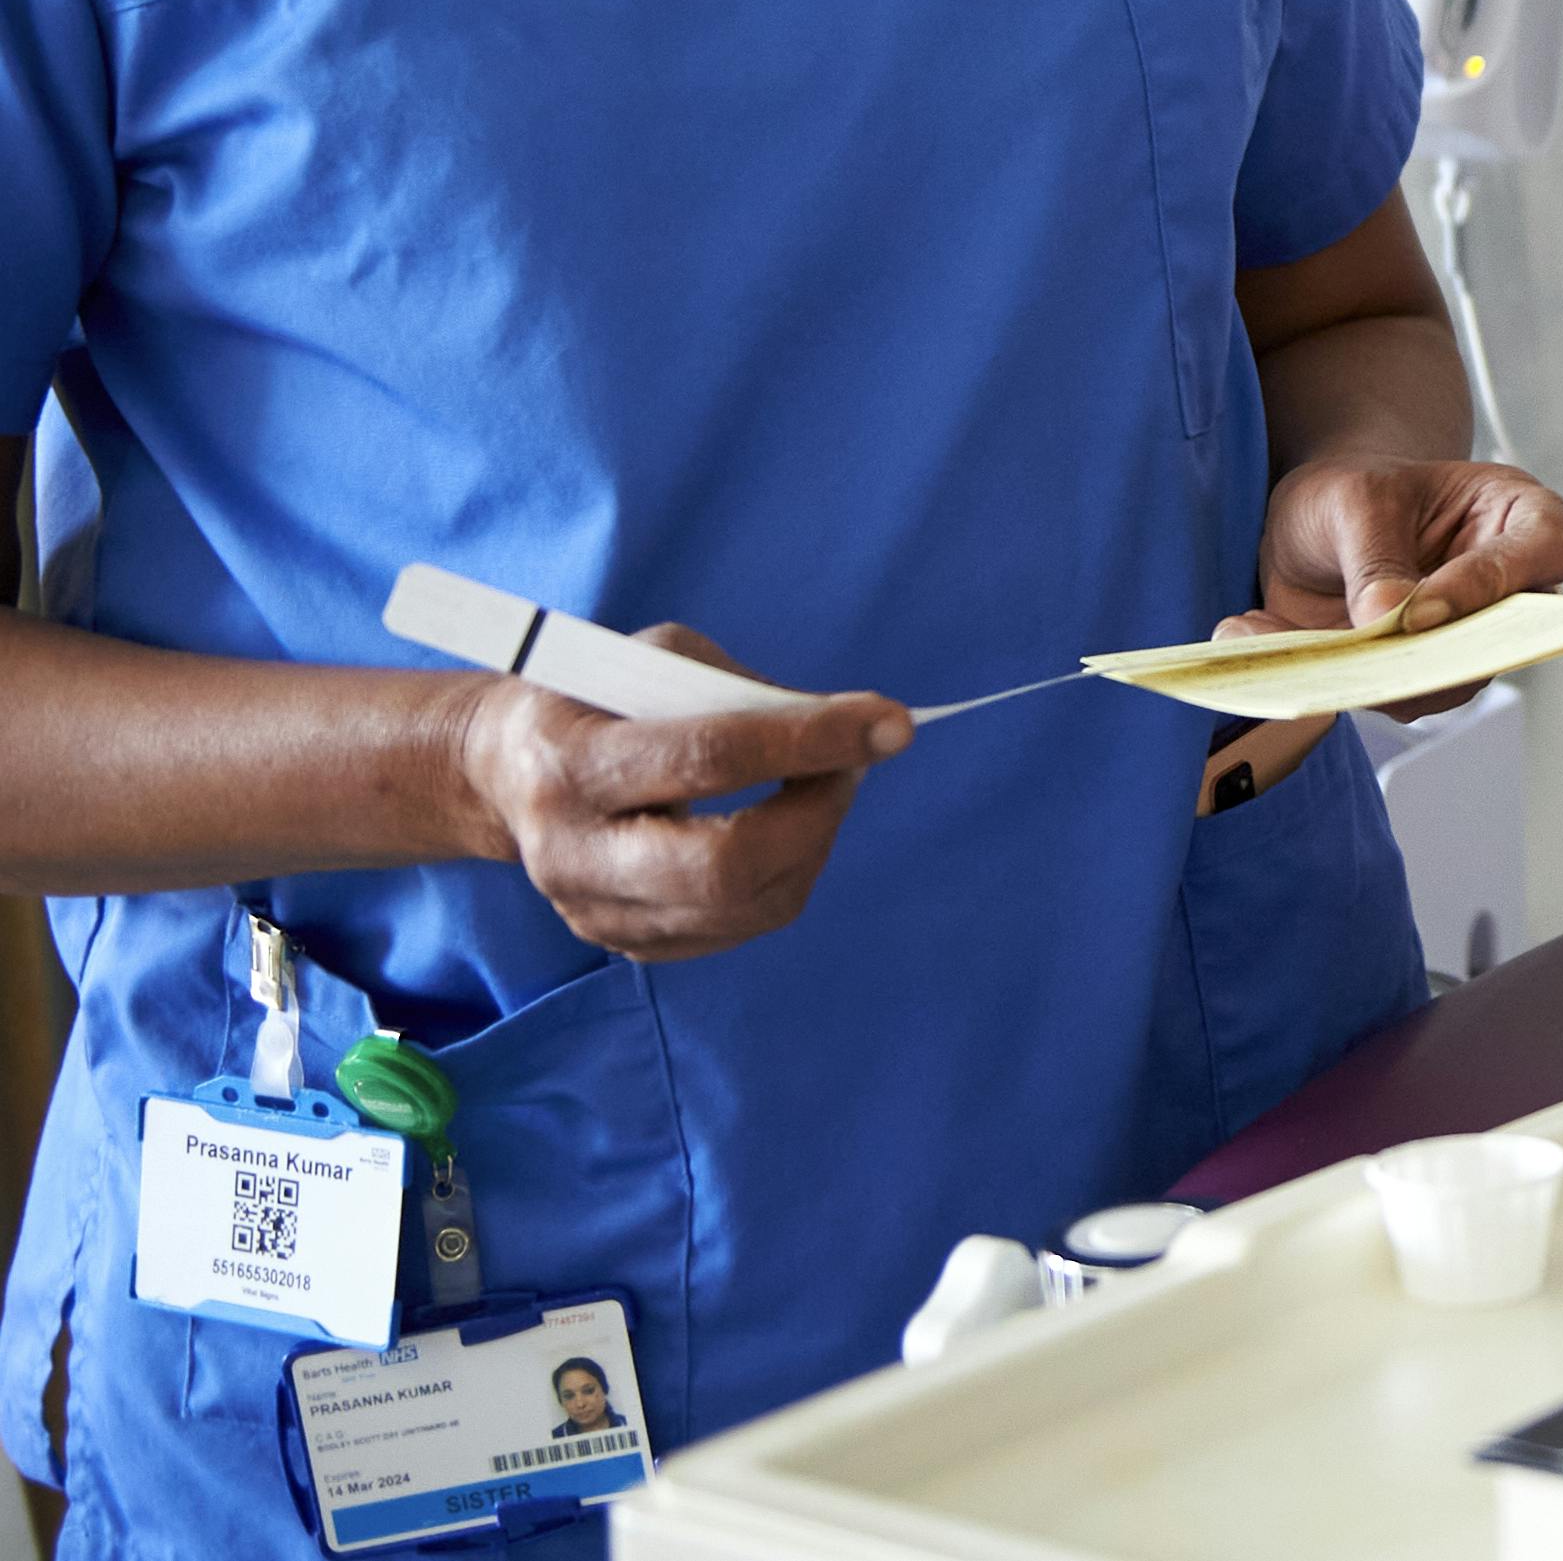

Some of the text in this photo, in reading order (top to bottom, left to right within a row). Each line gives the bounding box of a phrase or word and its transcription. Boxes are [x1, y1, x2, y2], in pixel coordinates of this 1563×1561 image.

[186, 1134, 280, 1170] Prasanna
[286, 1152, 353, 1183] Kumar
[212, 1257, 312, 1292] 551655302018
[303, 1366, 332, 1381] Barts
[335, 1358, 374, 1375] Health
[381, 1345, 418, 1365] NHS
[310, 1380, 454, 1417] PRASANNA KUMAR
[328, 1473, 412, 1499] 14 Mar 2024
